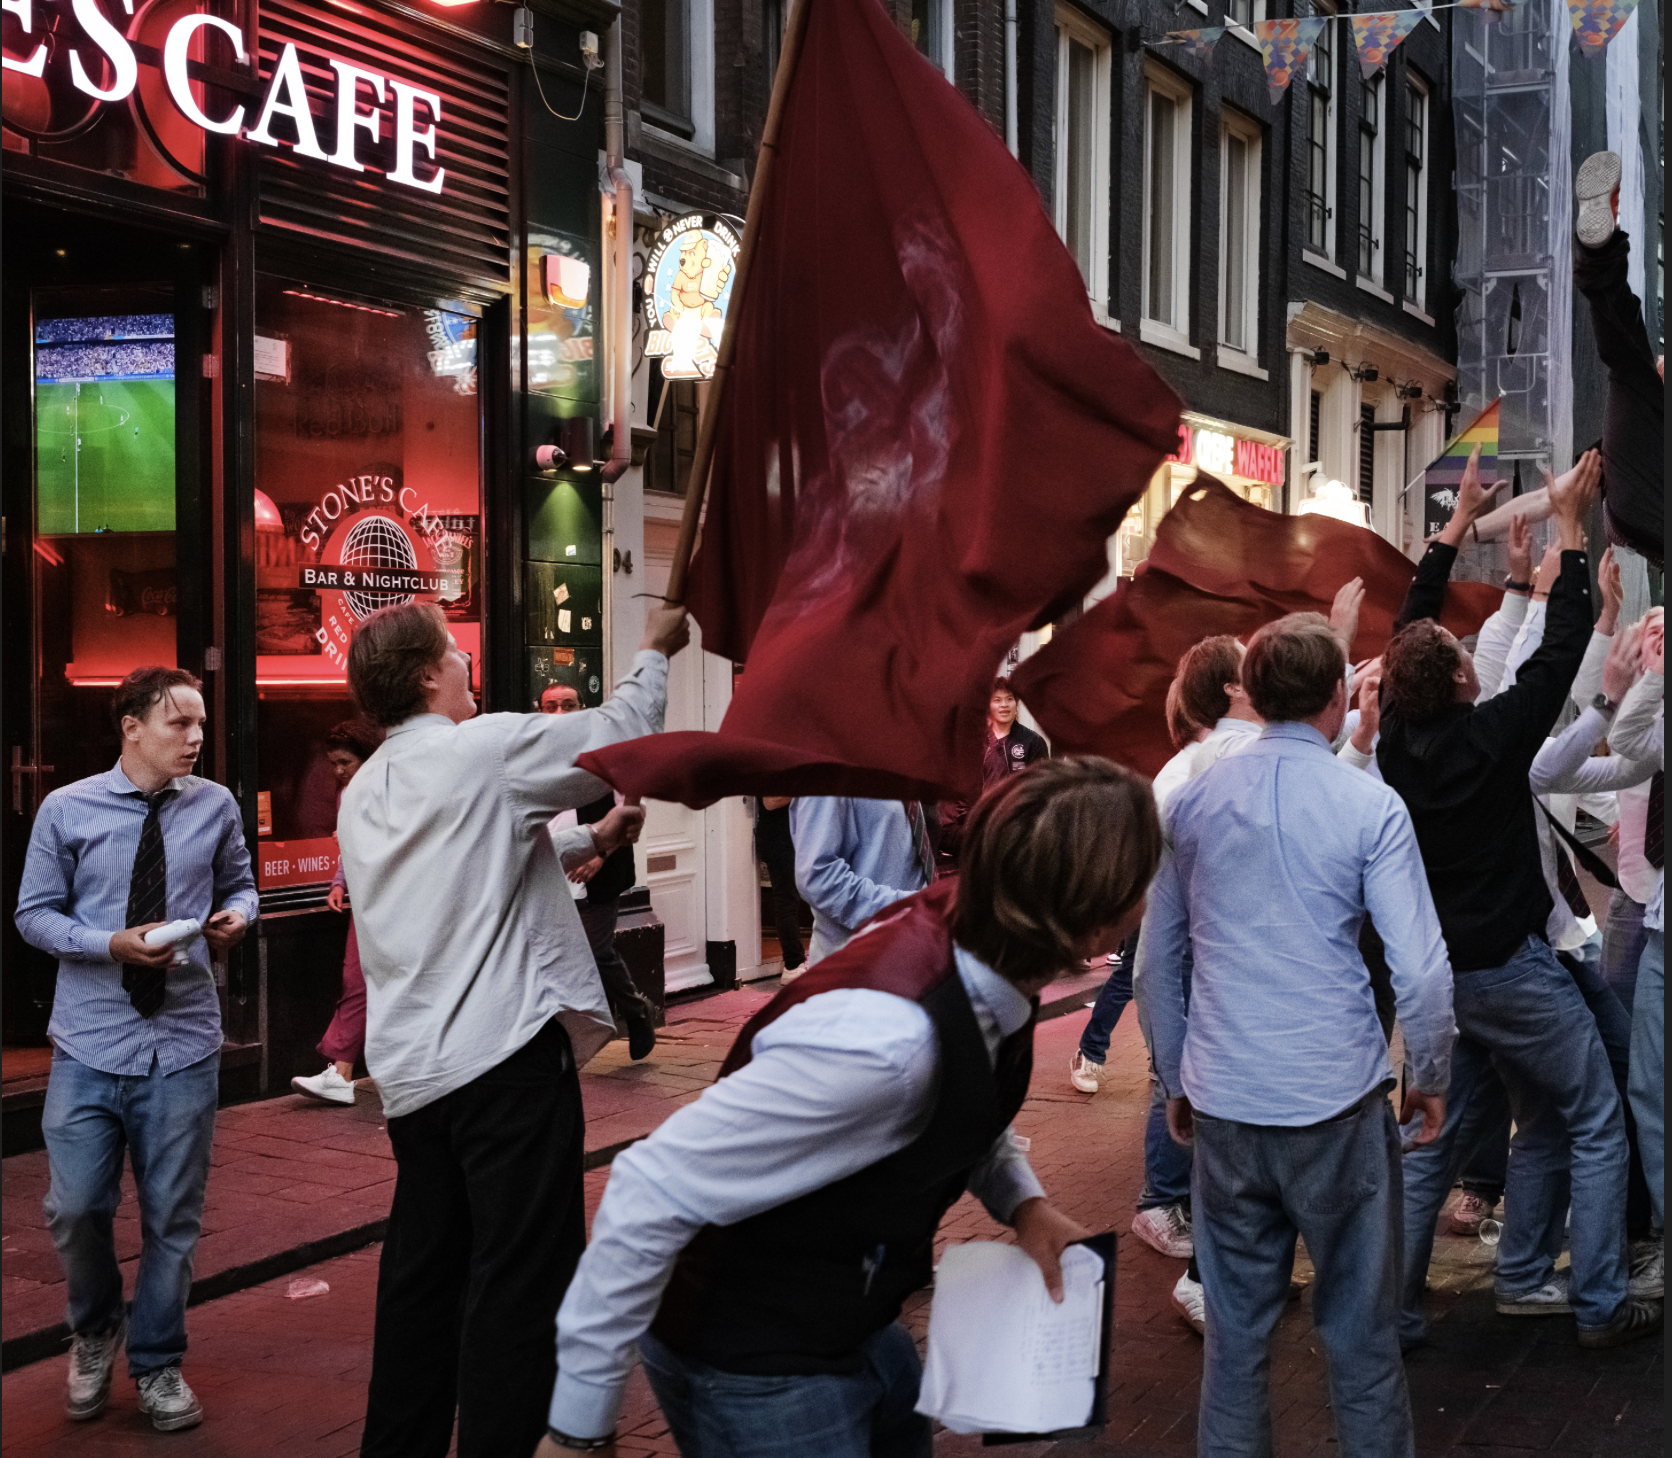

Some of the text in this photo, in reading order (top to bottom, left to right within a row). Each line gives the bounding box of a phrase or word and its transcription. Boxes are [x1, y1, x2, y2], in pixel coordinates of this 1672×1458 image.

[164, 13, 444, 194] CAFE
[645, 215, 741, 328] YOU WILL NEVER DRINK
[1236, 439, 1284, 486] WAFFLE
[301, 475, 452, 555] STONE'S CAFE
[343, 571, 356, 587] &
[328, 615, 348, 643] RED
[338, 598, 355, 625] CAFE
[265, 860, 290, 877] BEER
[298, 856, 330, 873] WINES
